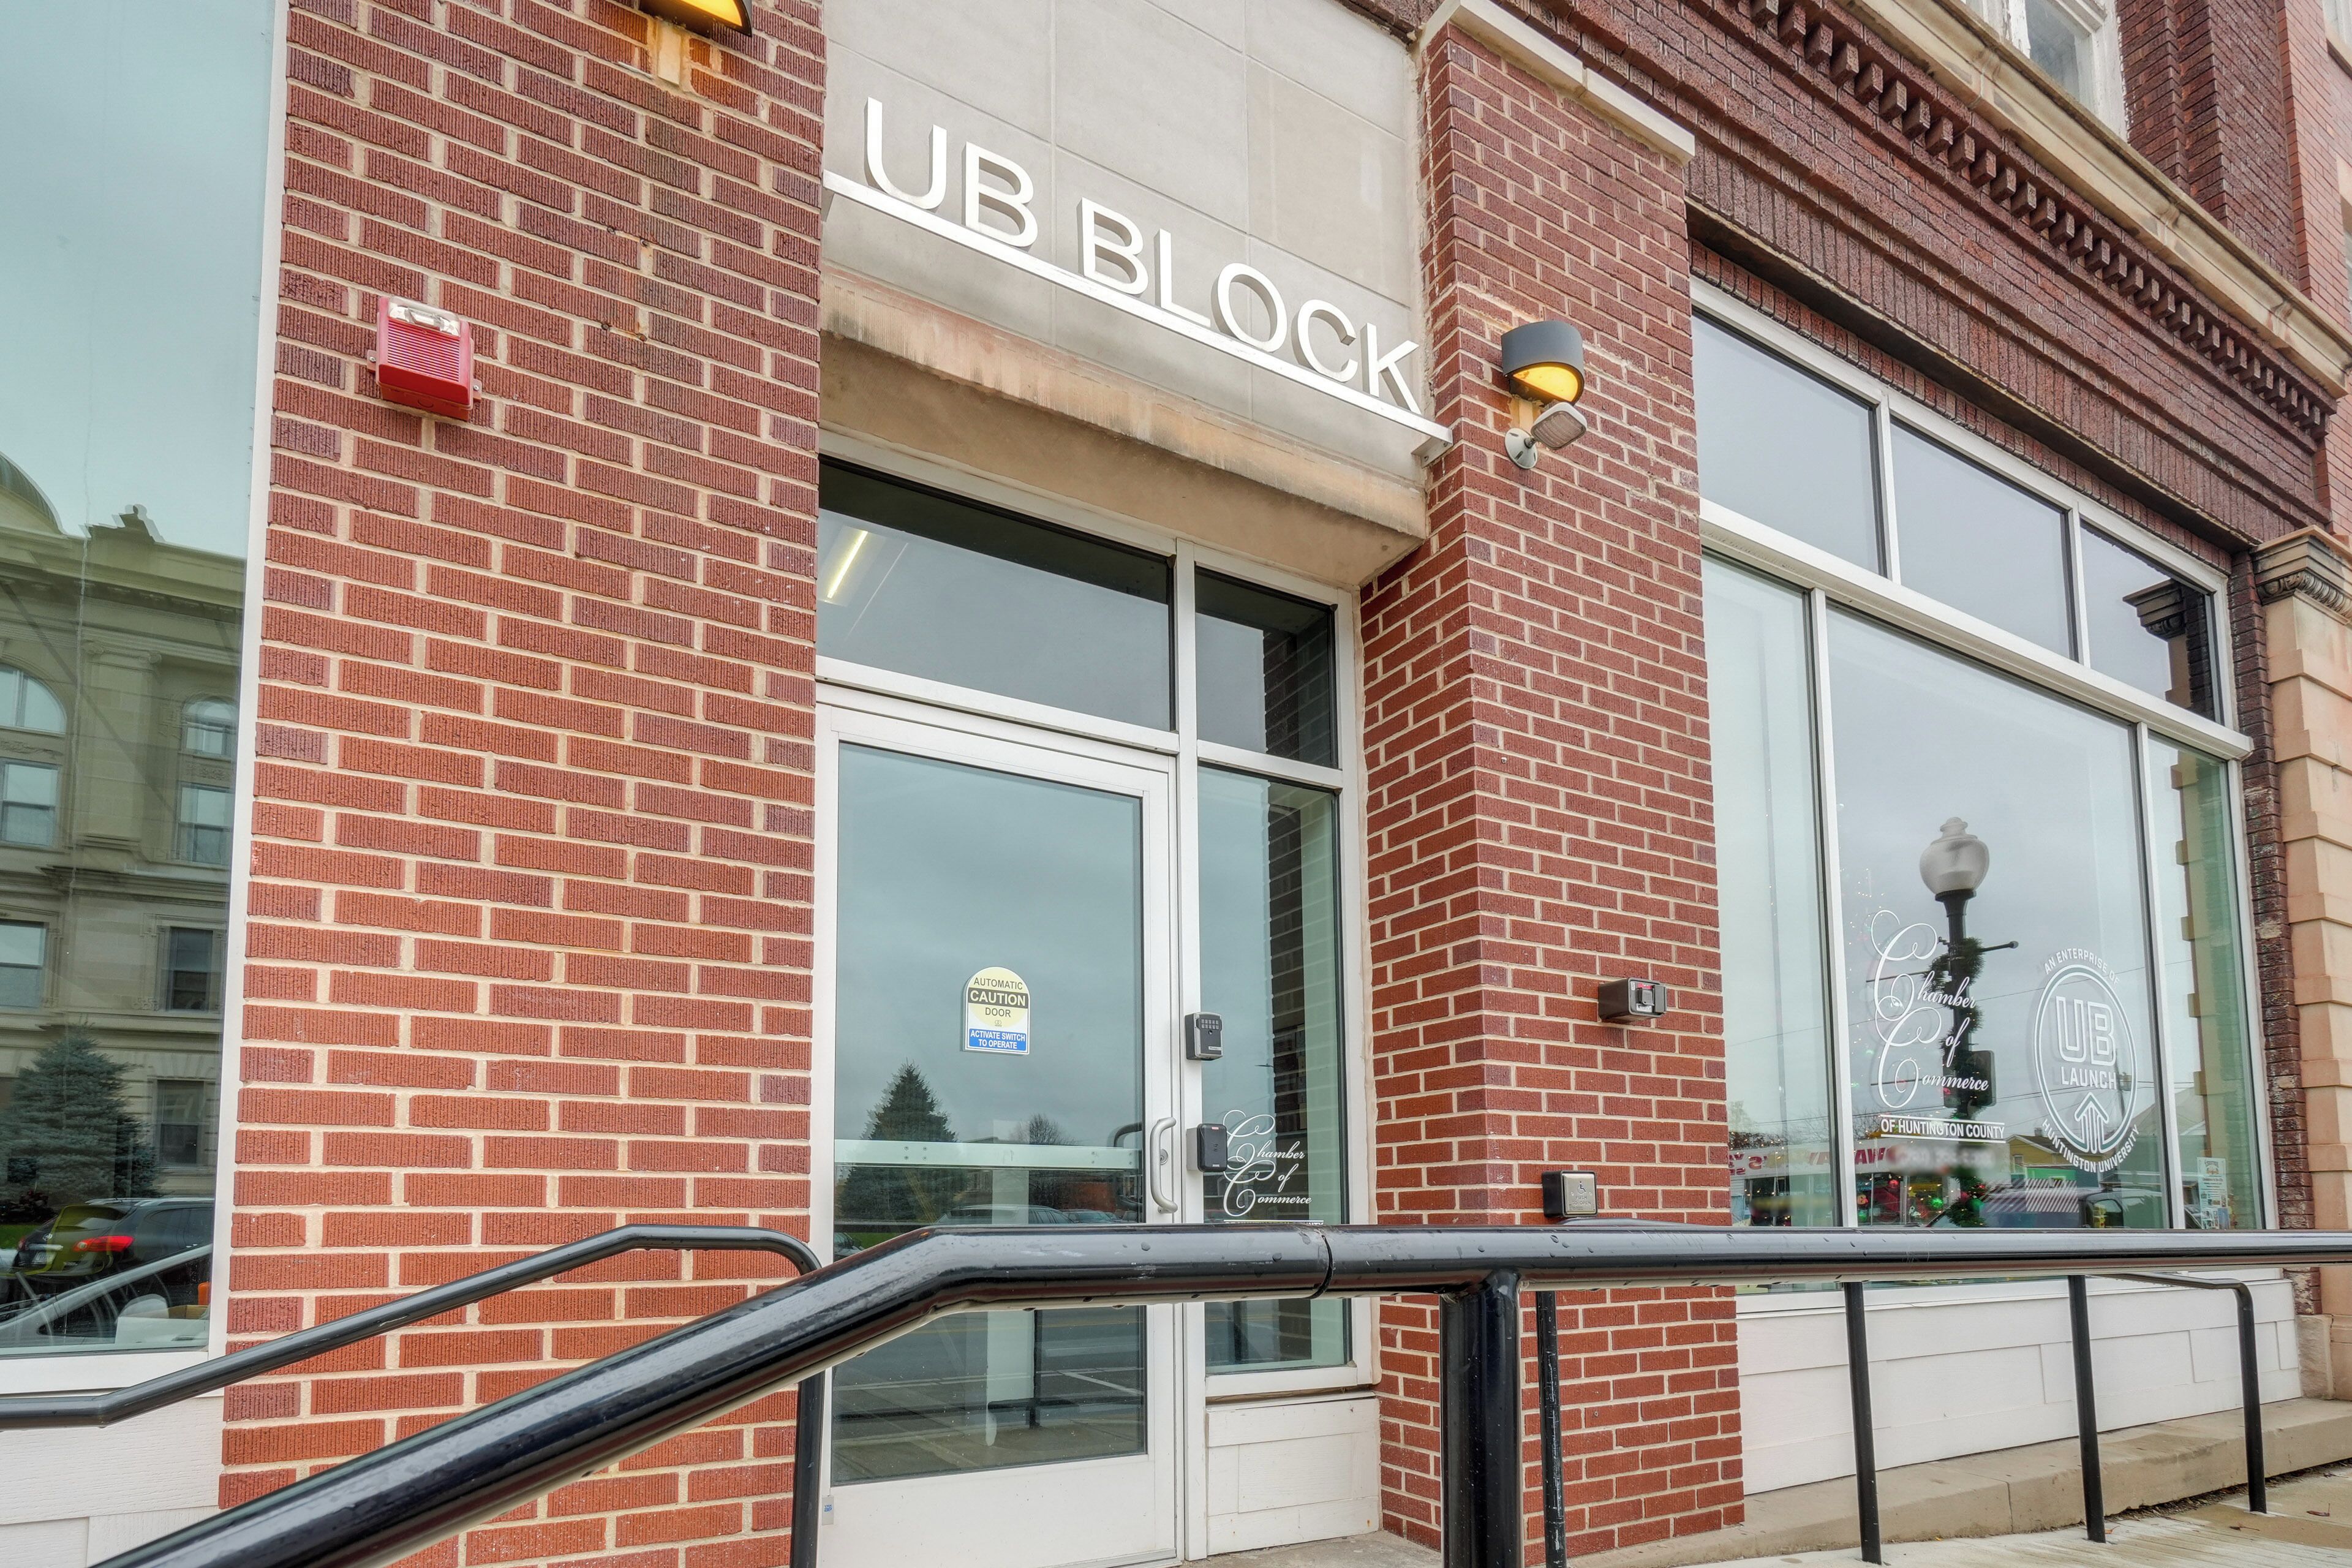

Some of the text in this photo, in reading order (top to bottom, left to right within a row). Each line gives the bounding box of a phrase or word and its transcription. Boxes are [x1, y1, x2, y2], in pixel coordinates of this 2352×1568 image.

[864, 97, 1421, 414] UB BLOCK
[973, 977, 1023, 990] AUTOMATIC
[1871, 910, 1976, 1021] Chamber
[2043, 948, 2120, 985] AN ENTERPRISE OF
[970, 990, 1026, 1006] CAUTION
[985, 1007, 1011, 1017] DOOR
[970, 1030, 1025, 1042] ACTIVATE SWITCH
[989, 1040, 1017, 1049] OPERATE
[1945, 1017, 1970, 1068] of
[2056, 996, 2116, 1066] UB
[1875, 995, 1989, 1108] Commerce
[2061, 1066, 2117, 1090] LAUNCH
[1223, 1110, 1306, 1170] Chamber
[1881, 1118, 2005, 1140] OF HUNTINGTON COUNTY
[2042, 1118, 2097, 1173] HUNTINGTON
[2098, 1124, 2139, 1172] UNIVERSITY
[1223, 1155, 1312, 1216] Commerce
[1278, 1164, 1299, 1193] of
